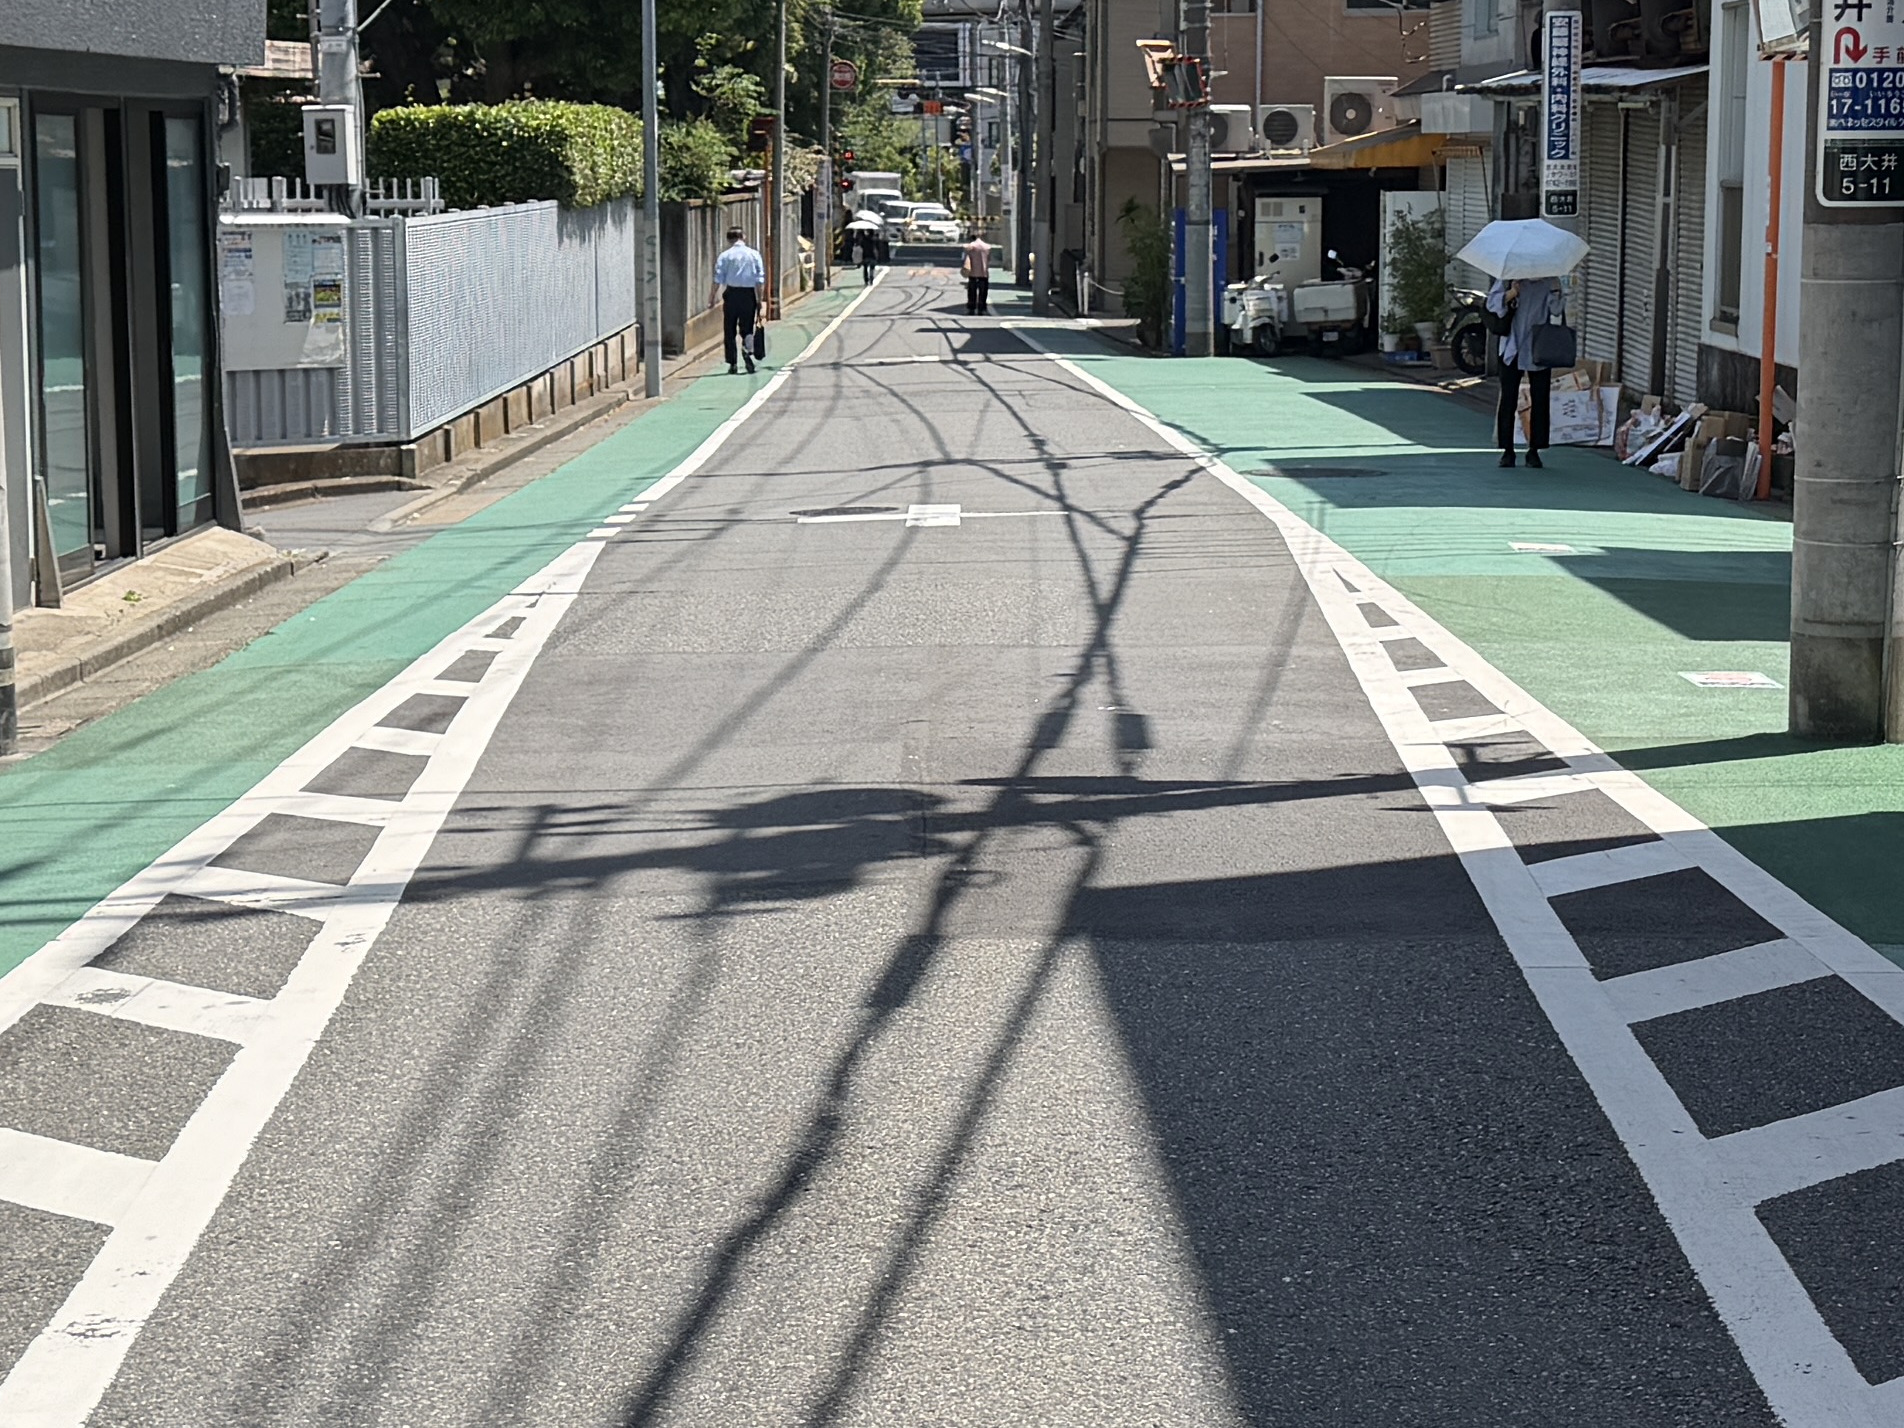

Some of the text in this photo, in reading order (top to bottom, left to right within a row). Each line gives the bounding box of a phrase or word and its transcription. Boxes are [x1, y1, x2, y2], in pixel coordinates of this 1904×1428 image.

[1839, 152, 1898, 171] 西大井
[1841, 176, 1891, 195] 5-11
